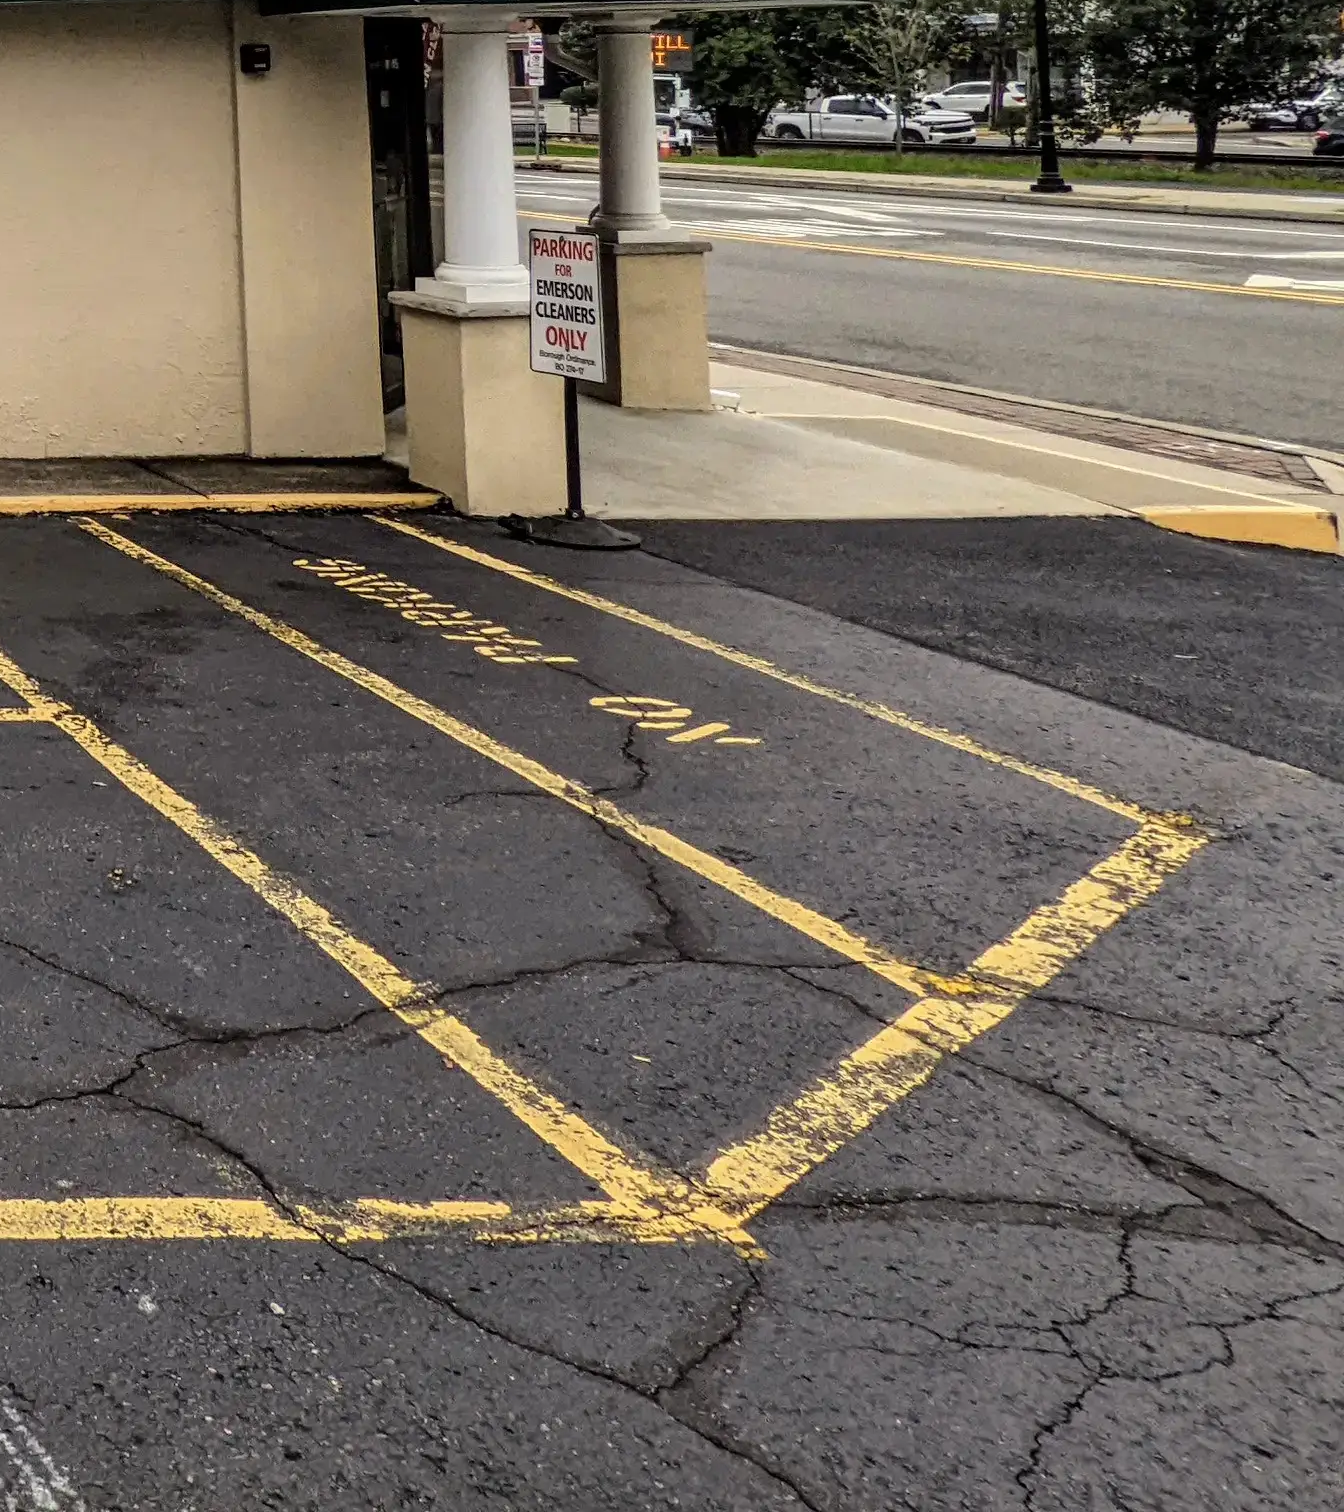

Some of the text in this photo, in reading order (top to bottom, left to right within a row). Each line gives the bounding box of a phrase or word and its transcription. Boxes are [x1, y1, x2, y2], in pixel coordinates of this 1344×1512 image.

[533, 237, 594, 262] PARKING
[555, 264, 572, 277] FOR
[536, 279, 593, 302] EMERSON
[535, 301, 596, 325] CLEANERS
[545, 325, 588, 351] ONLY
